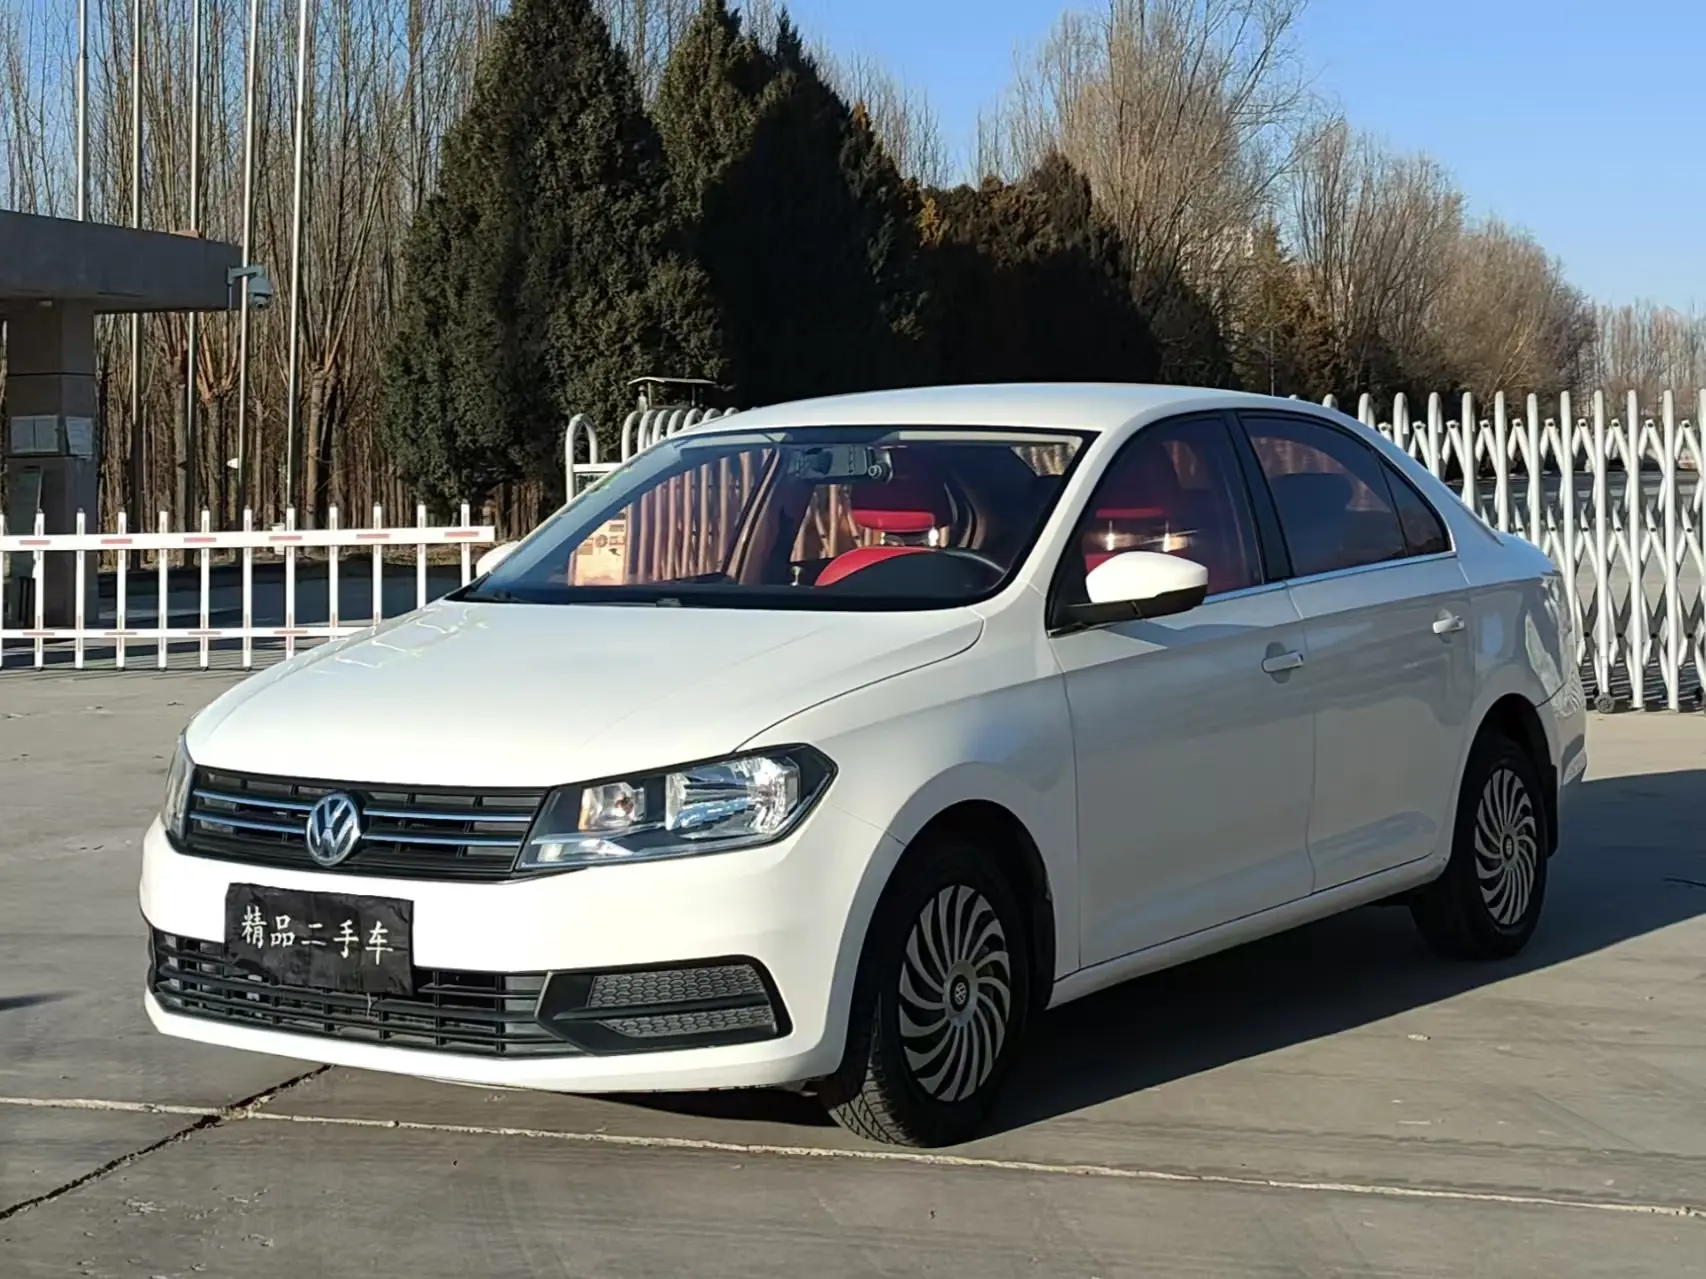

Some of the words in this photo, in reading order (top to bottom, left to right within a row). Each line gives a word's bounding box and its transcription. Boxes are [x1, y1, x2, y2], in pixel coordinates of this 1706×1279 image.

[241, 905, 394, 965] 精品二手车
